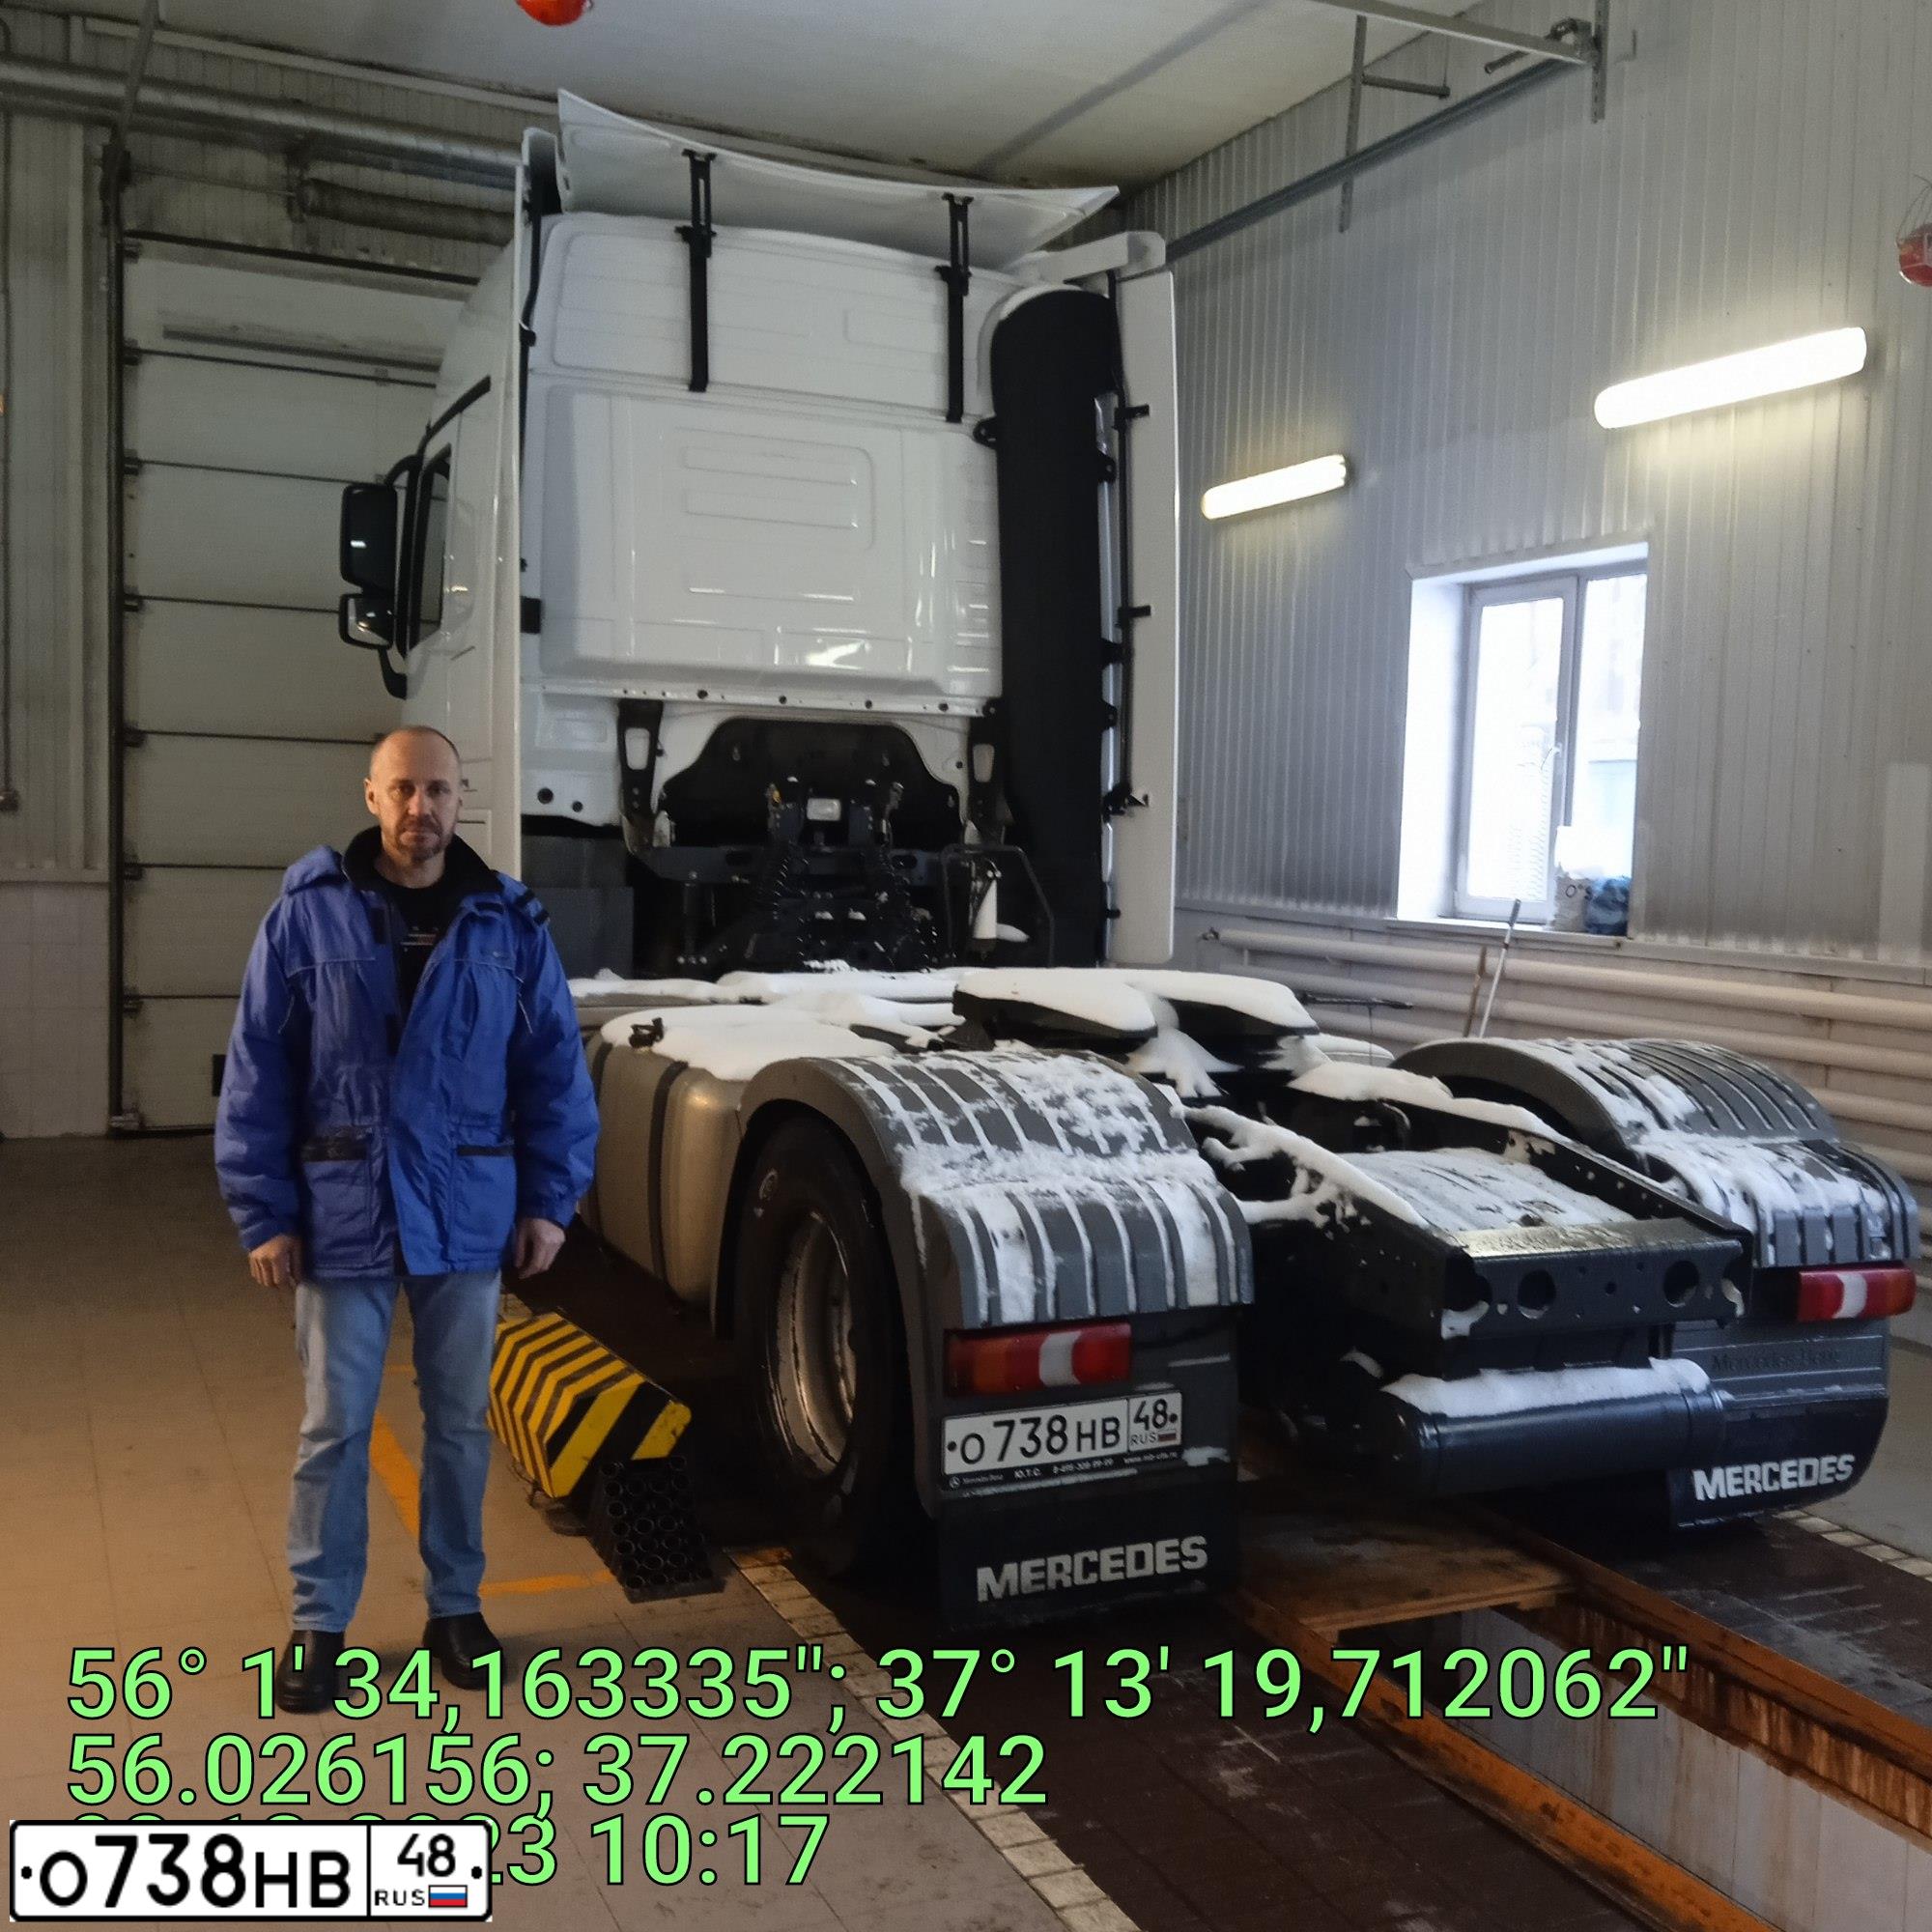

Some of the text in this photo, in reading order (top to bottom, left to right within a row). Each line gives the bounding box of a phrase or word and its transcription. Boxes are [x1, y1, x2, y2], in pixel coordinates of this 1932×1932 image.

[1133, 1398, 1169, 1432] 48
[1129, 1432, 1158, 1446] RUS
[1692, 1453, 1857, 1501] MERCEDES
[976, 1534, 1209, 1603] MERCEDES
